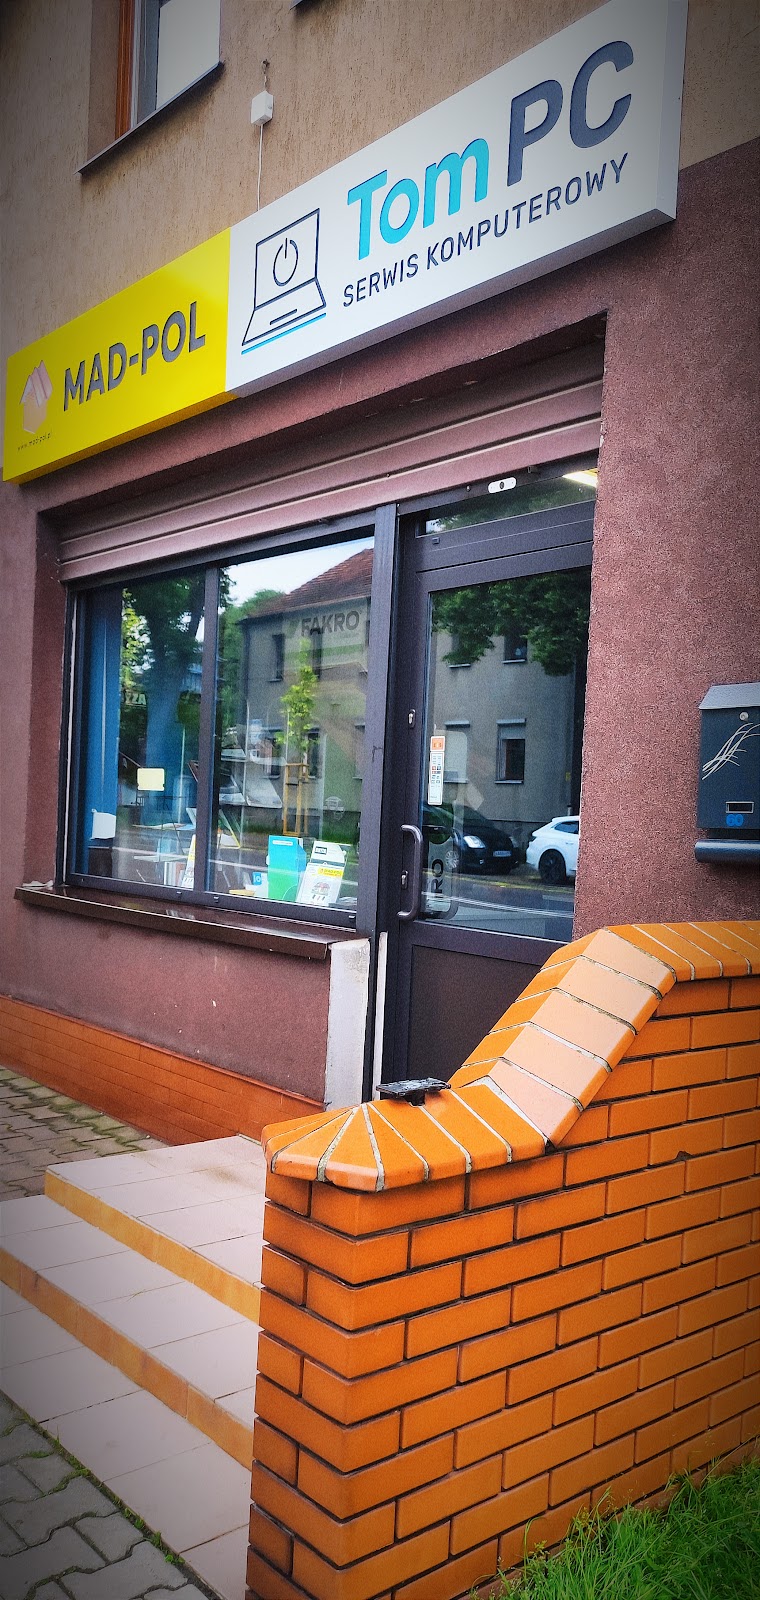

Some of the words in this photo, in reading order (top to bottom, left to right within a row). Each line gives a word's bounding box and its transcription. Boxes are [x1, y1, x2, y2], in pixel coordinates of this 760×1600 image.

[347, 138, 489, 260] Tom
[507, 40, 634, 186] PC
[343, 253, 419, 307] SERWIS
[427, 152, 628, 270] KOMPUTEROWY
[63, 301, 206, 411] MAD-POL
[301, 610, 359, 636] FAKRO
